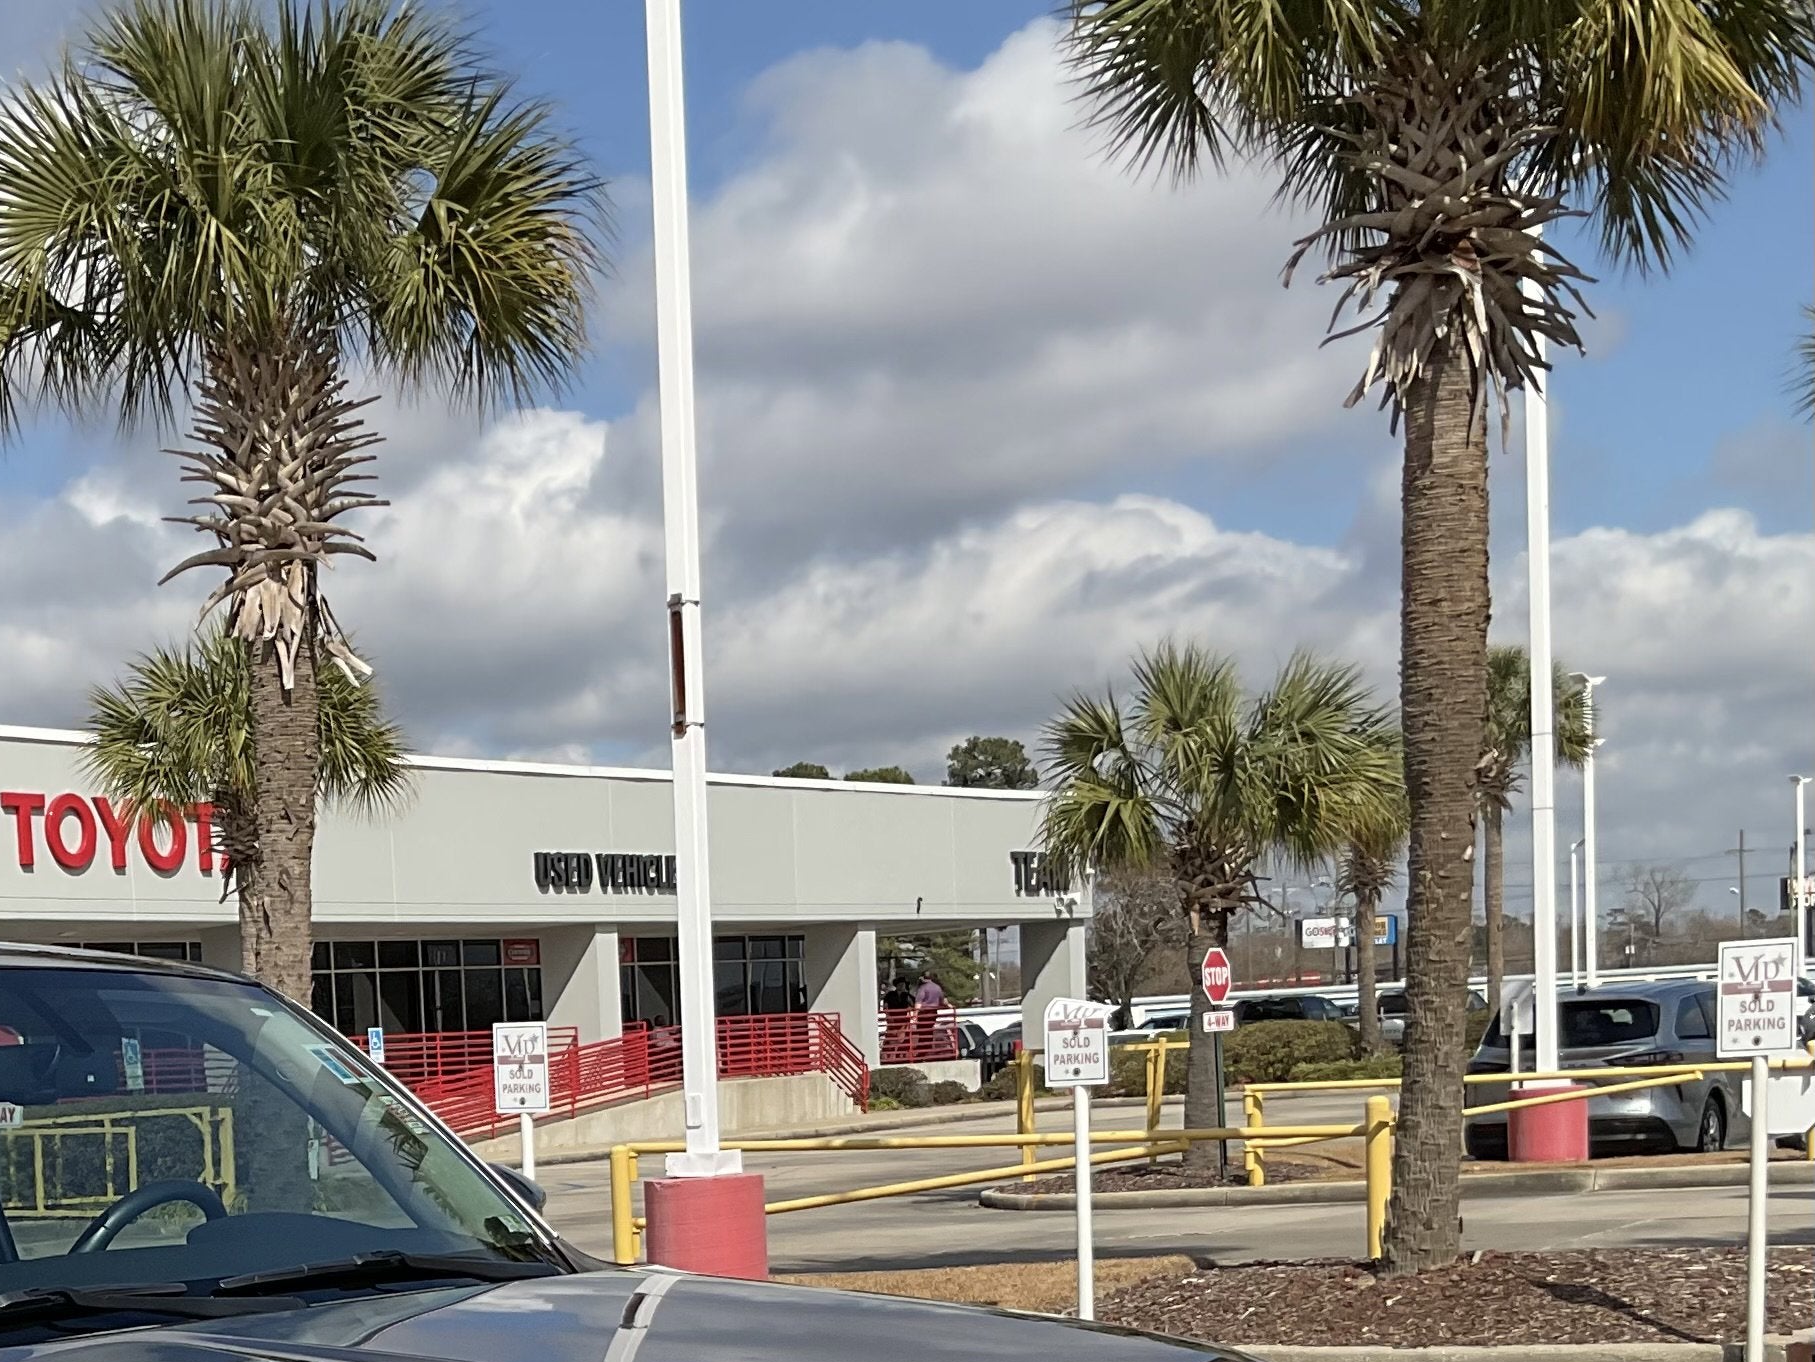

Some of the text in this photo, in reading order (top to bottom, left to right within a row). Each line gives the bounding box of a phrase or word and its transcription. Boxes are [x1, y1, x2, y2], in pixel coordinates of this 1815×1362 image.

[0, 791, 234, 873] TOYOT
[533, 852, 594, 888] USED
[1204, 967, 1228, 986] STOP
[1739, 1000, 1775, 1014] SOLD
[1206, 1014, 1230, 1028] 4-WAY
[1727, 1016, 1786, 1032] PARKING
[1062, 1036, 1091, 1049] SOLD
[1053, 1052, 1100, 1066] PARKING
[509, 1069, 534, 1080] SOLD
[502, 1083, 541, 1094] PARKING
